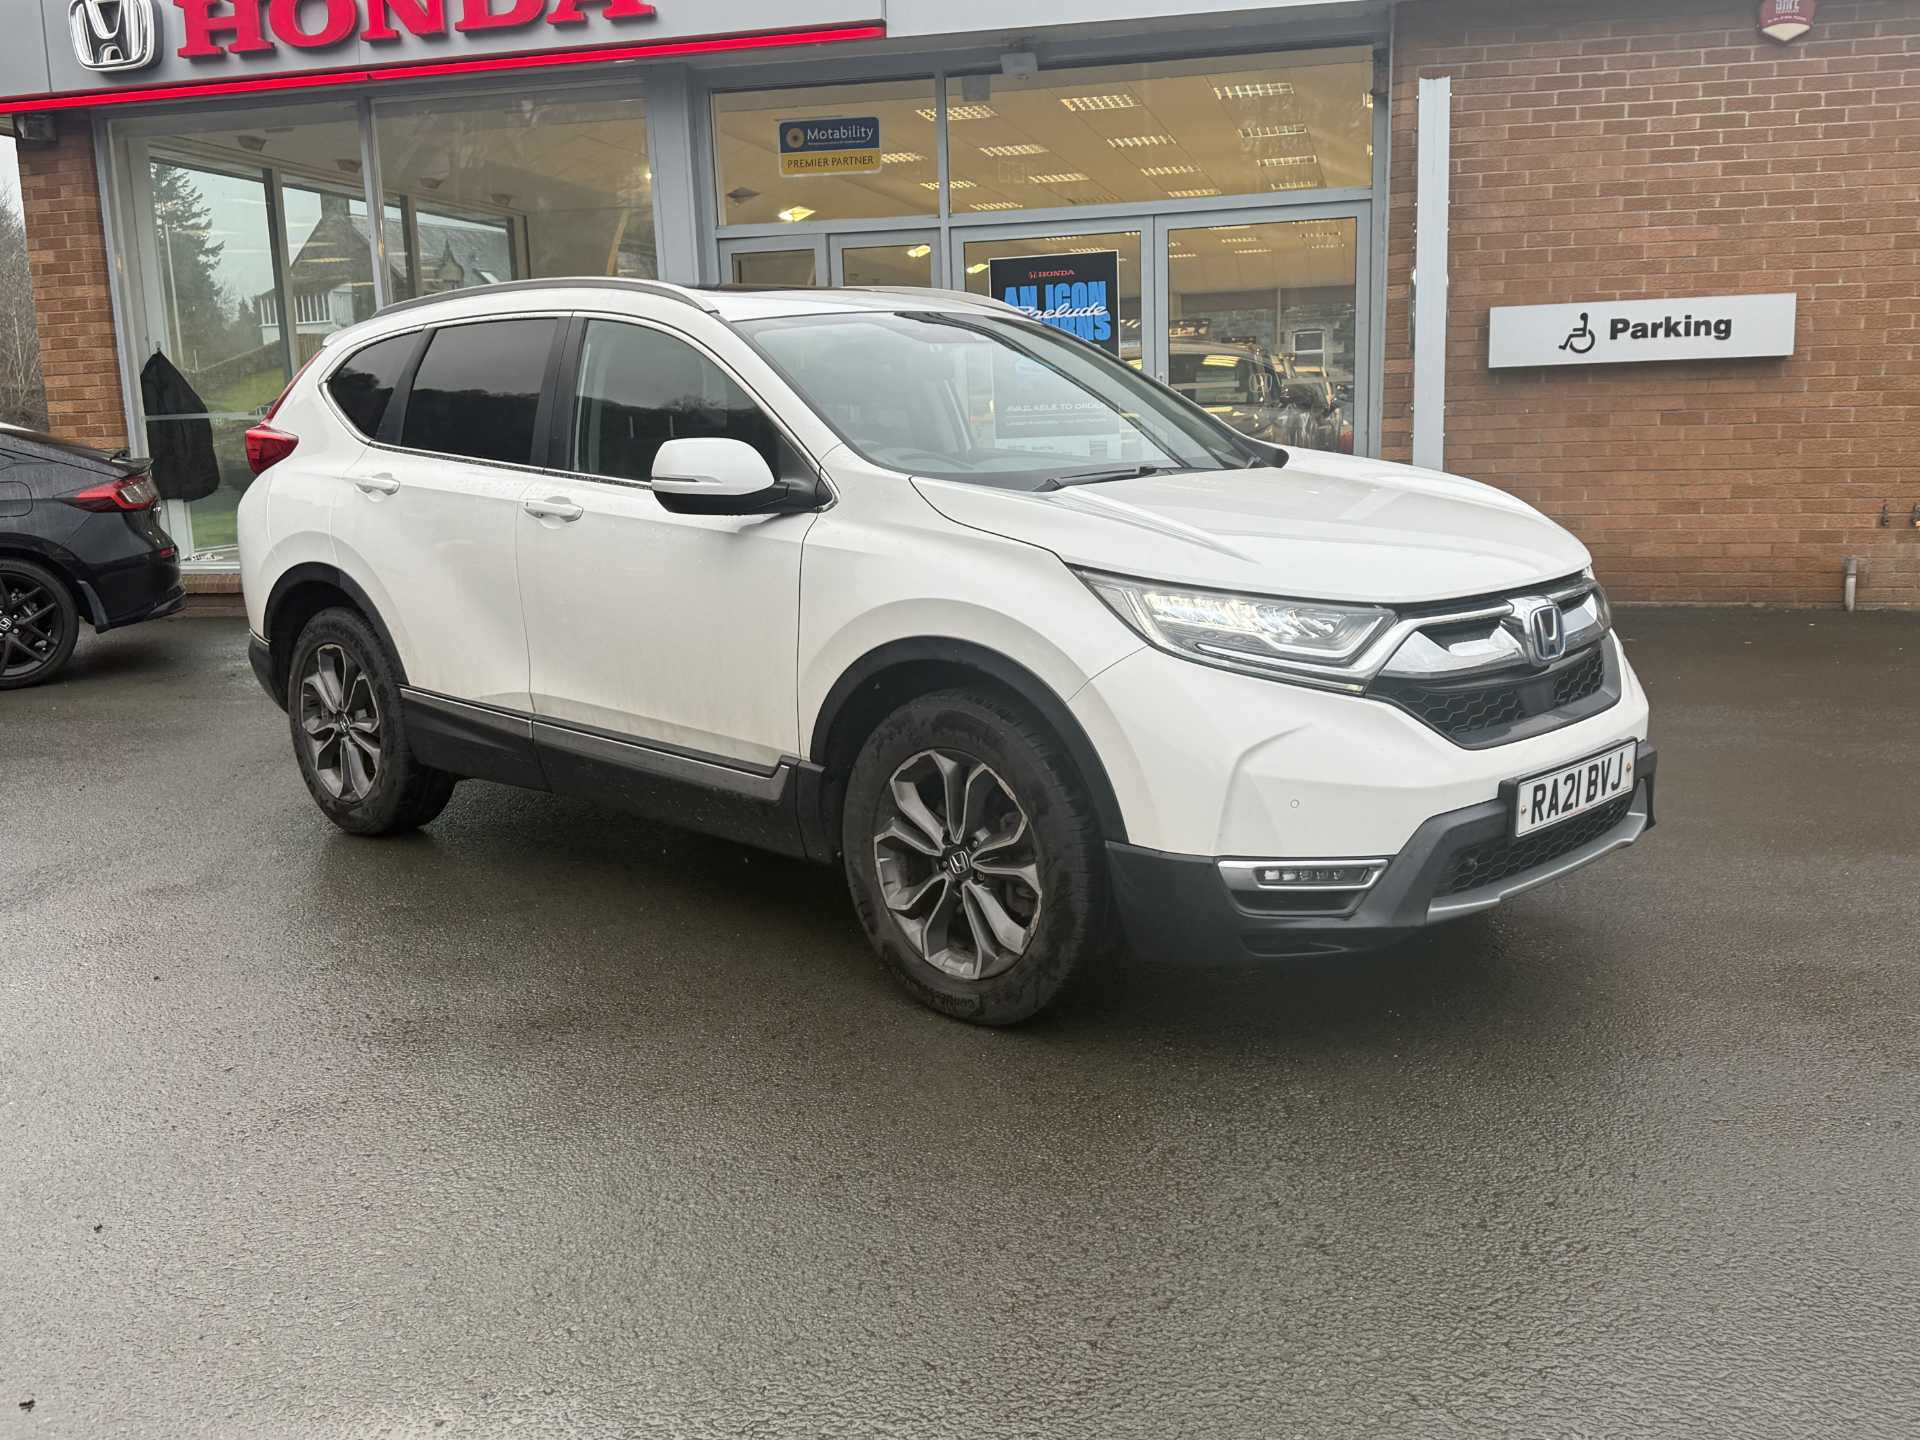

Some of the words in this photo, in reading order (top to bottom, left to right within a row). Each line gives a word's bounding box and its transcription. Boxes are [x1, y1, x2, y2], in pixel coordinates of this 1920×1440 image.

[807, 125, 874, 141] Motability
[787, 158, 830, 169] PREMIER
[831, 155, 874, 167] PARTNER
[1038, 269, 1075, 278] HONDA
[1045, 281, 1107, 311] ICON
[1609, 314, 1732, 341] Parking
[1531, 769, 1582, 825] RA21
[1585, 752, 1624, 803] BVJ
